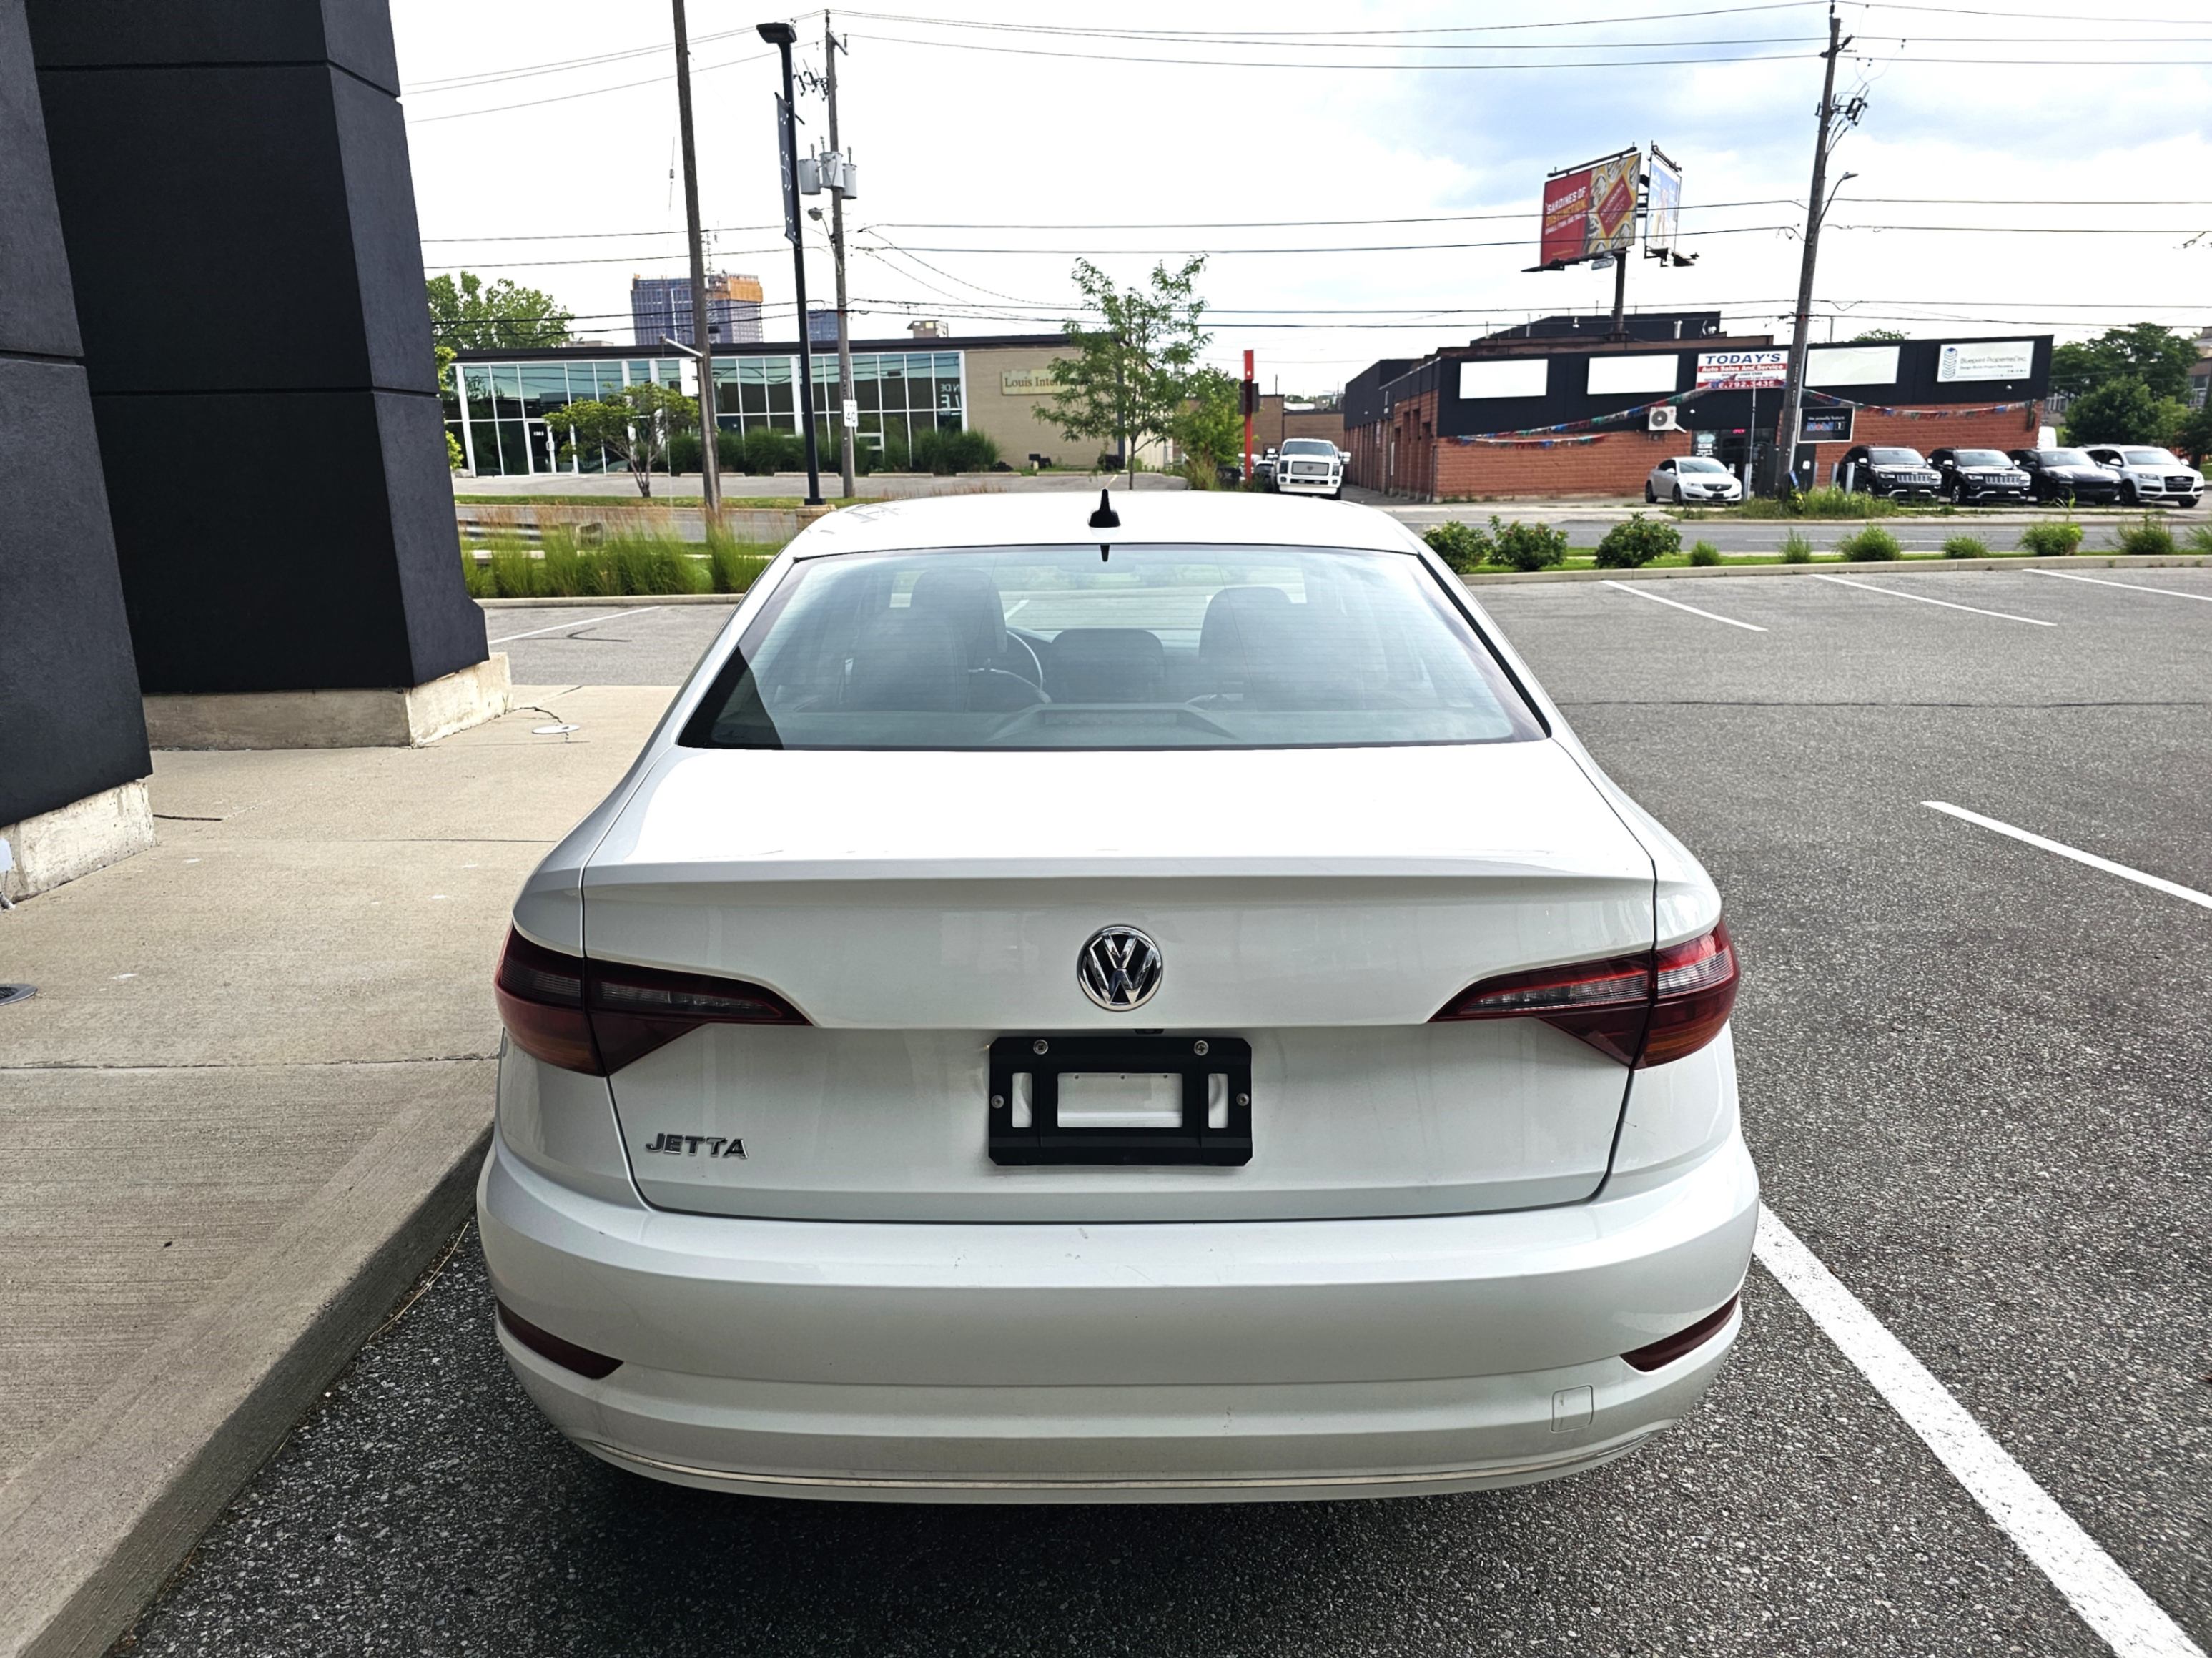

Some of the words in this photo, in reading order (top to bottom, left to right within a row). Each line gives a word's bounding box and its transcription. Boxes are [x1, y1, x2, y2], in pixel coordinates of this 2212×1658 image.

[1705, 353, 1782, 365] TODAY'S
[1004, 376, 1032, 388] Louis
[846, 411, 856, 423] 40
[646, 1133, 748, 1159] JETTA
